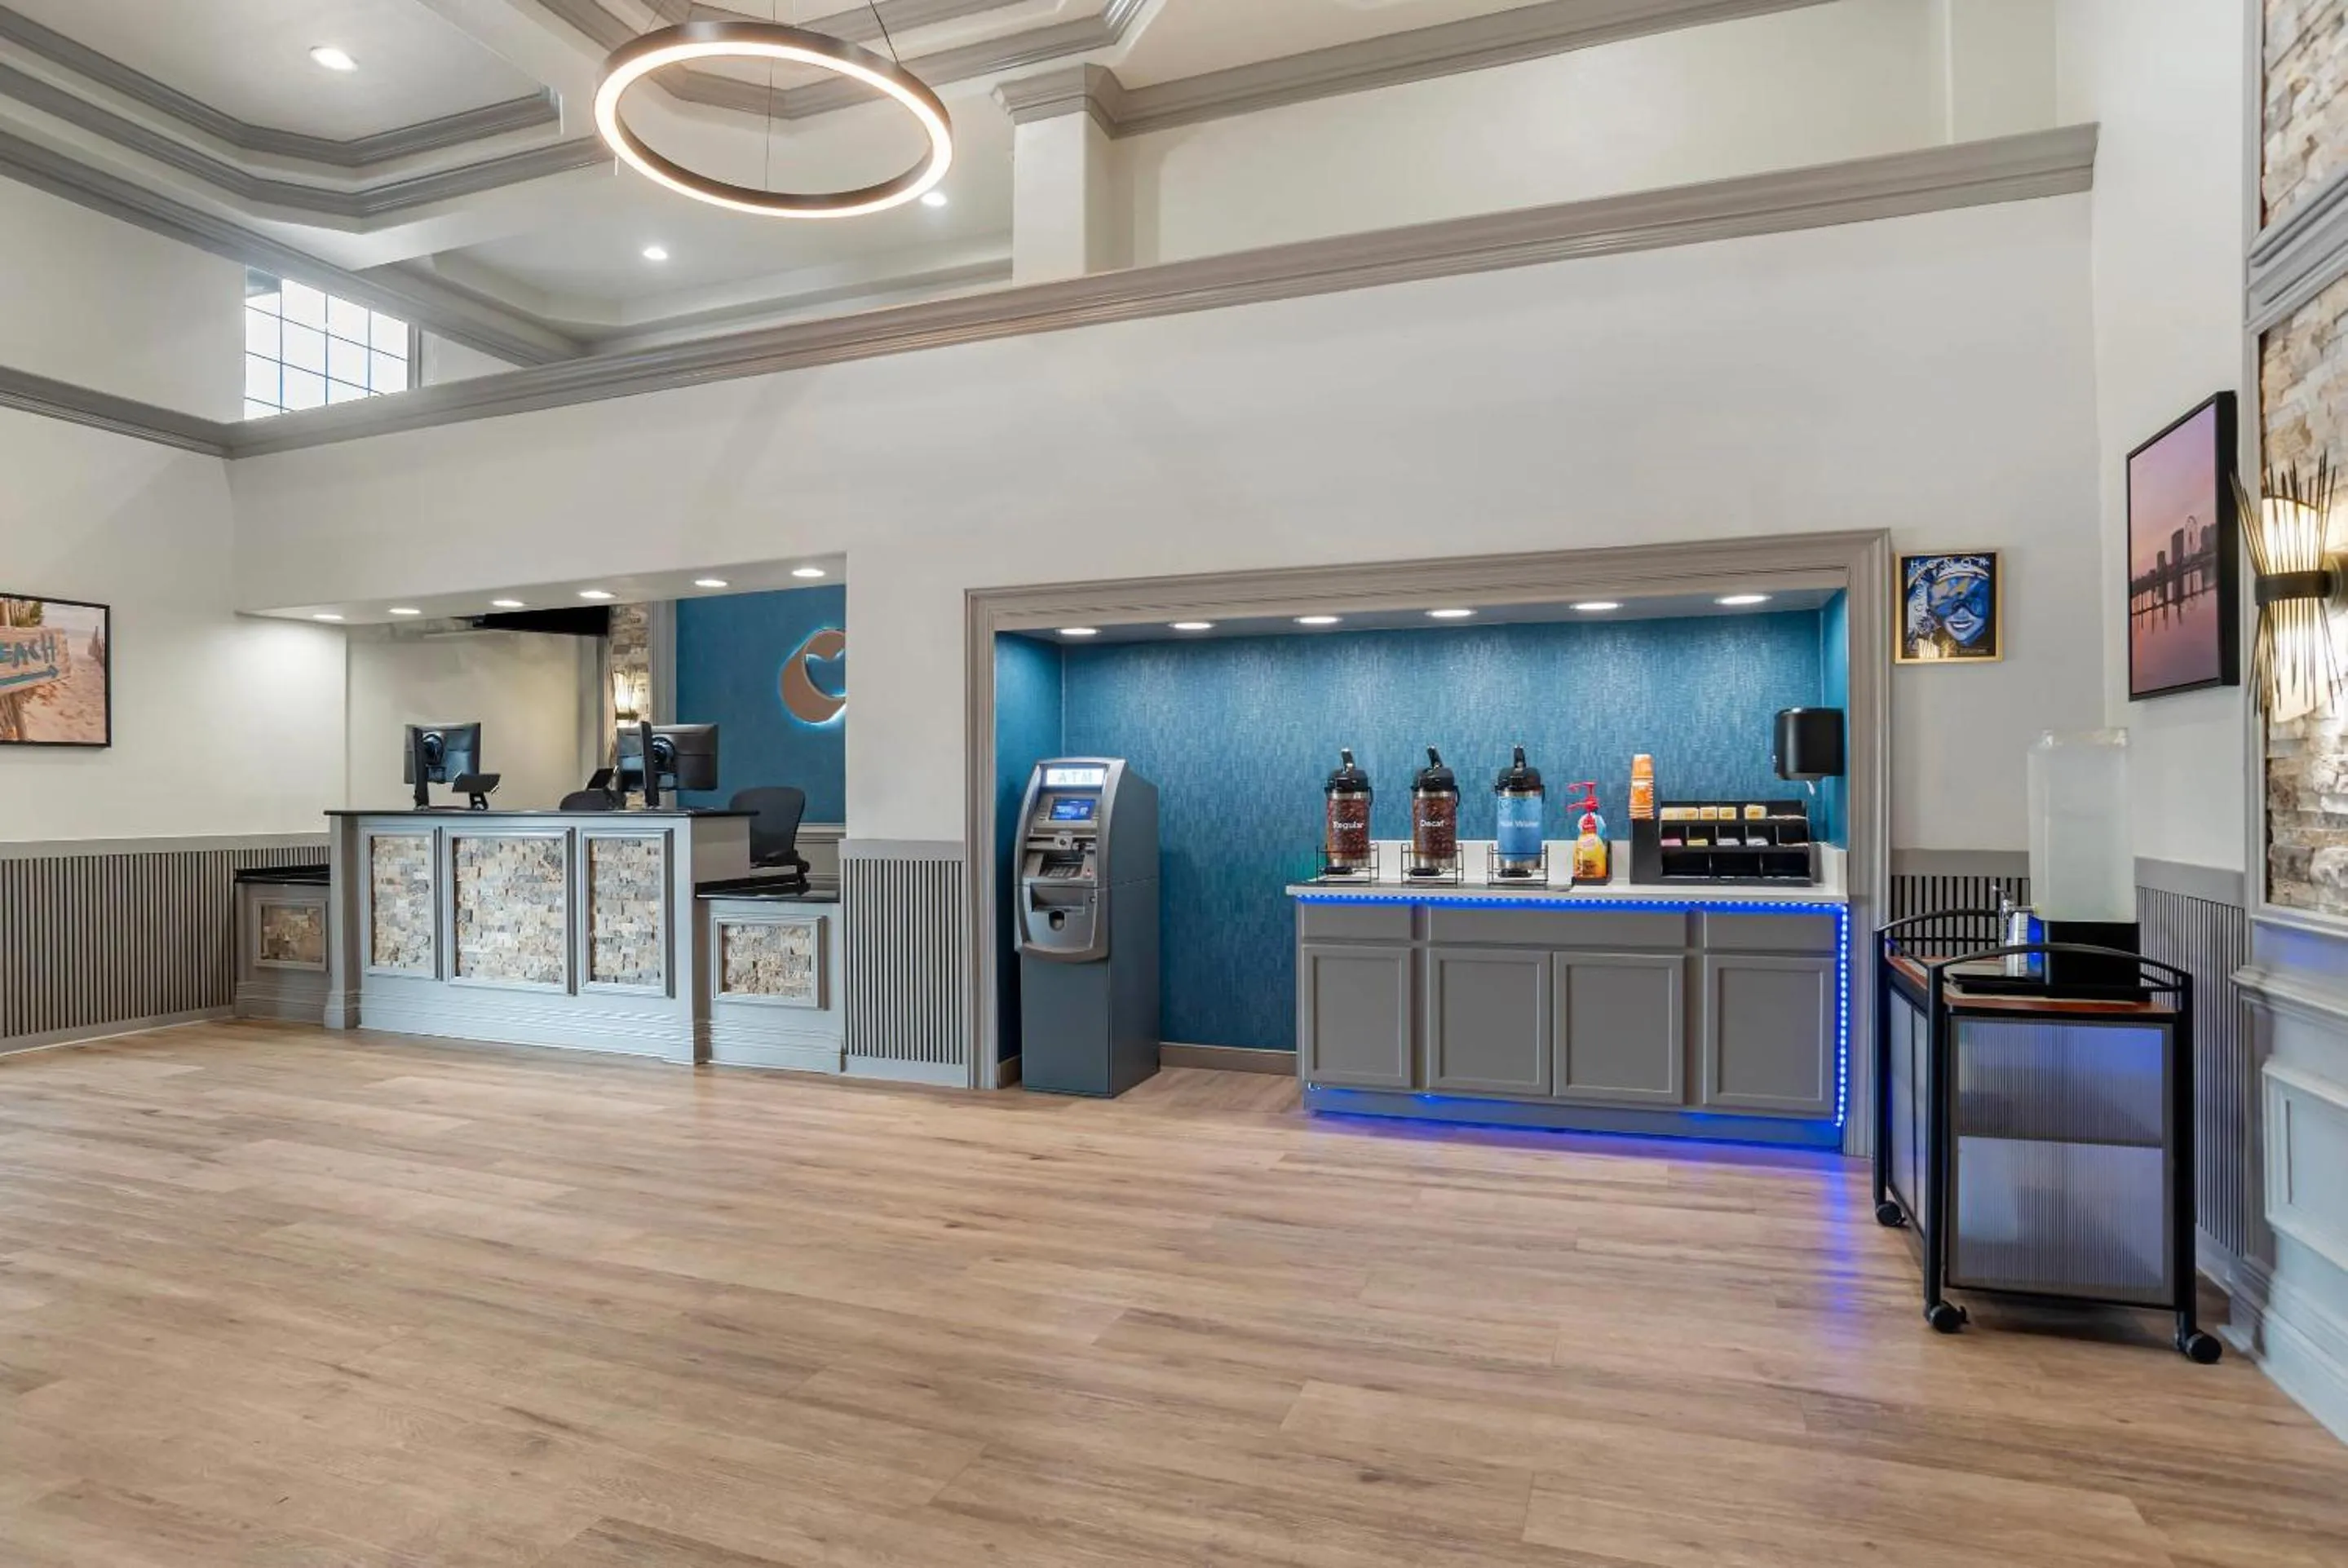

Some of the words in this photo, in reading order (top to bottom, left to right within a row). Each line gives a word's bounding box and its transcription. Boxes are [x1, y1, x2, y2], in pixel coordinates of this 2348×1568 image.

[1058, 771, 1093, 783] ATM
[1333, 820, 1364, 830] Regular
[1419, 819, 1445, 828] Decaf
